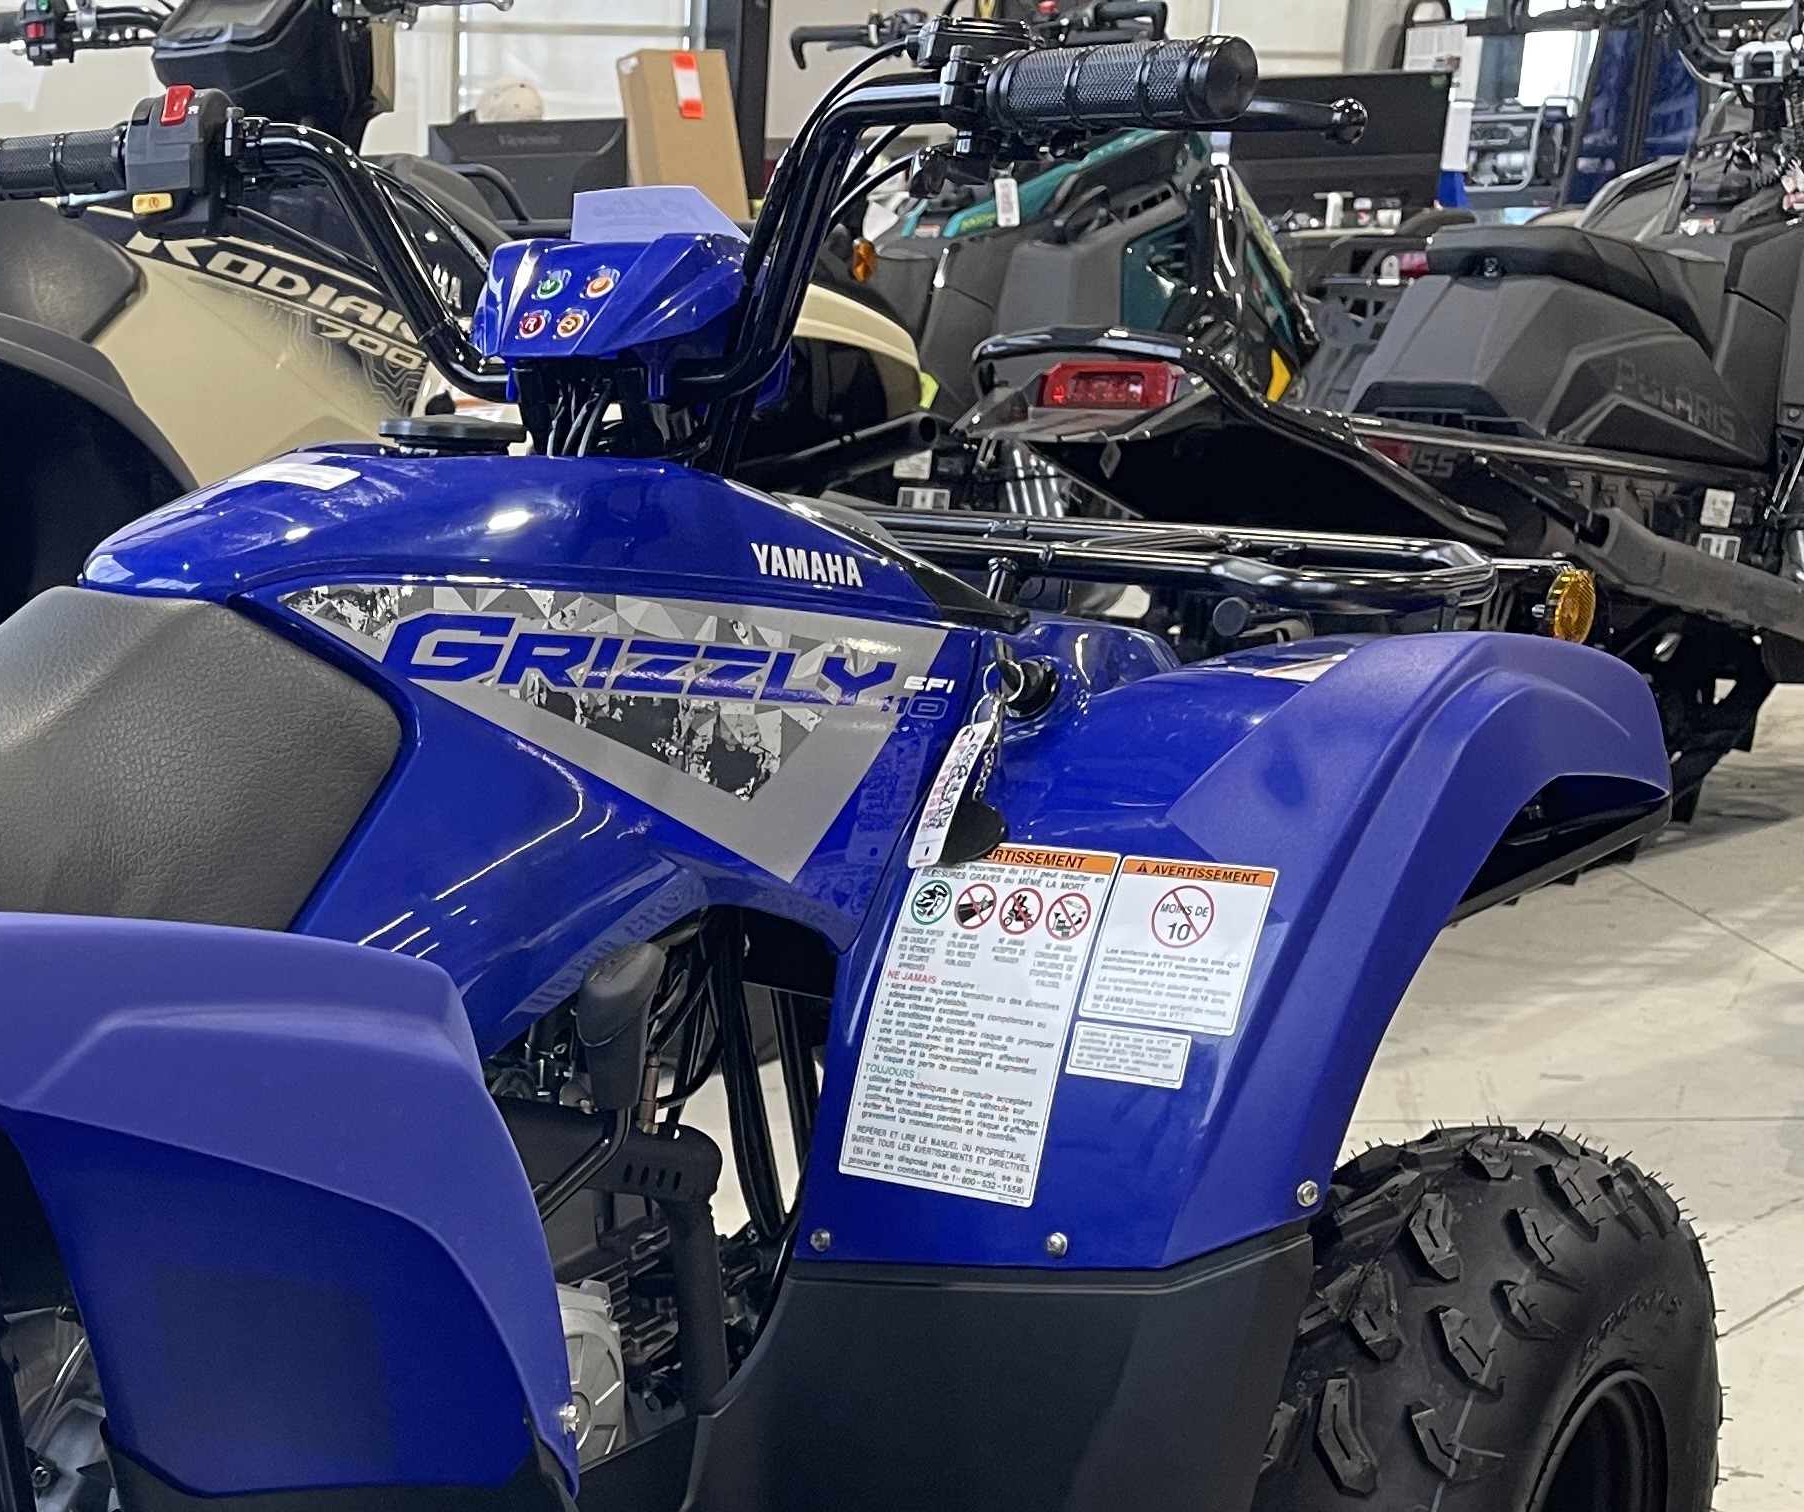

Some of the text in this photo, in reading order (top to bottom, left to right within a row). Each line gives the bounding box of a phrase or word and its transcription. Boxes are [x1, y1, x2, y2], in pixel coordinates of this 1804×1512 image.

[524, 316, 538, 331] R
[315, 317, 422, 371] 700
[1614, 355, 1737, 443] POLARIS
[751, 543, 863, 587] YAMAHA
[380, 613, 895, 704] GRIZZLY
[903, 676, 956, 695] EFI
[983, 847, 1087, 869] ERTISSEMENT
[920, 867, 966, 880] BLESSURES
[968, 872, 1001, 883] GRAVES
[1017, 876, 1042, 887] MÊME
[1044, 880, 1057, 889] LA
[1021, 868, 1037, 877] VTT
[1039, 870, 1058, 880] peut
[1151, 863, 1260, 884] AVERTISSEMENT
[1159, 902, 1209, 917] MOINS DE
[1164, 921, 1192, 941] 10
[1104, 946, 1119, 954] Les
[1156, 961, 1172, 969] VTT
[886, 969, 975, 989] NE JAMAIS conduire
[864, 1063, 915, 1078] TOUJOURS
[889, 1130, 898, 1139] ET
[918, 1135, 927, 1144] LE
[897, 1141, 911, 1152] LES
[975, 1154, 985, 1165] ET
[883, 1163, 893, 1171] en
